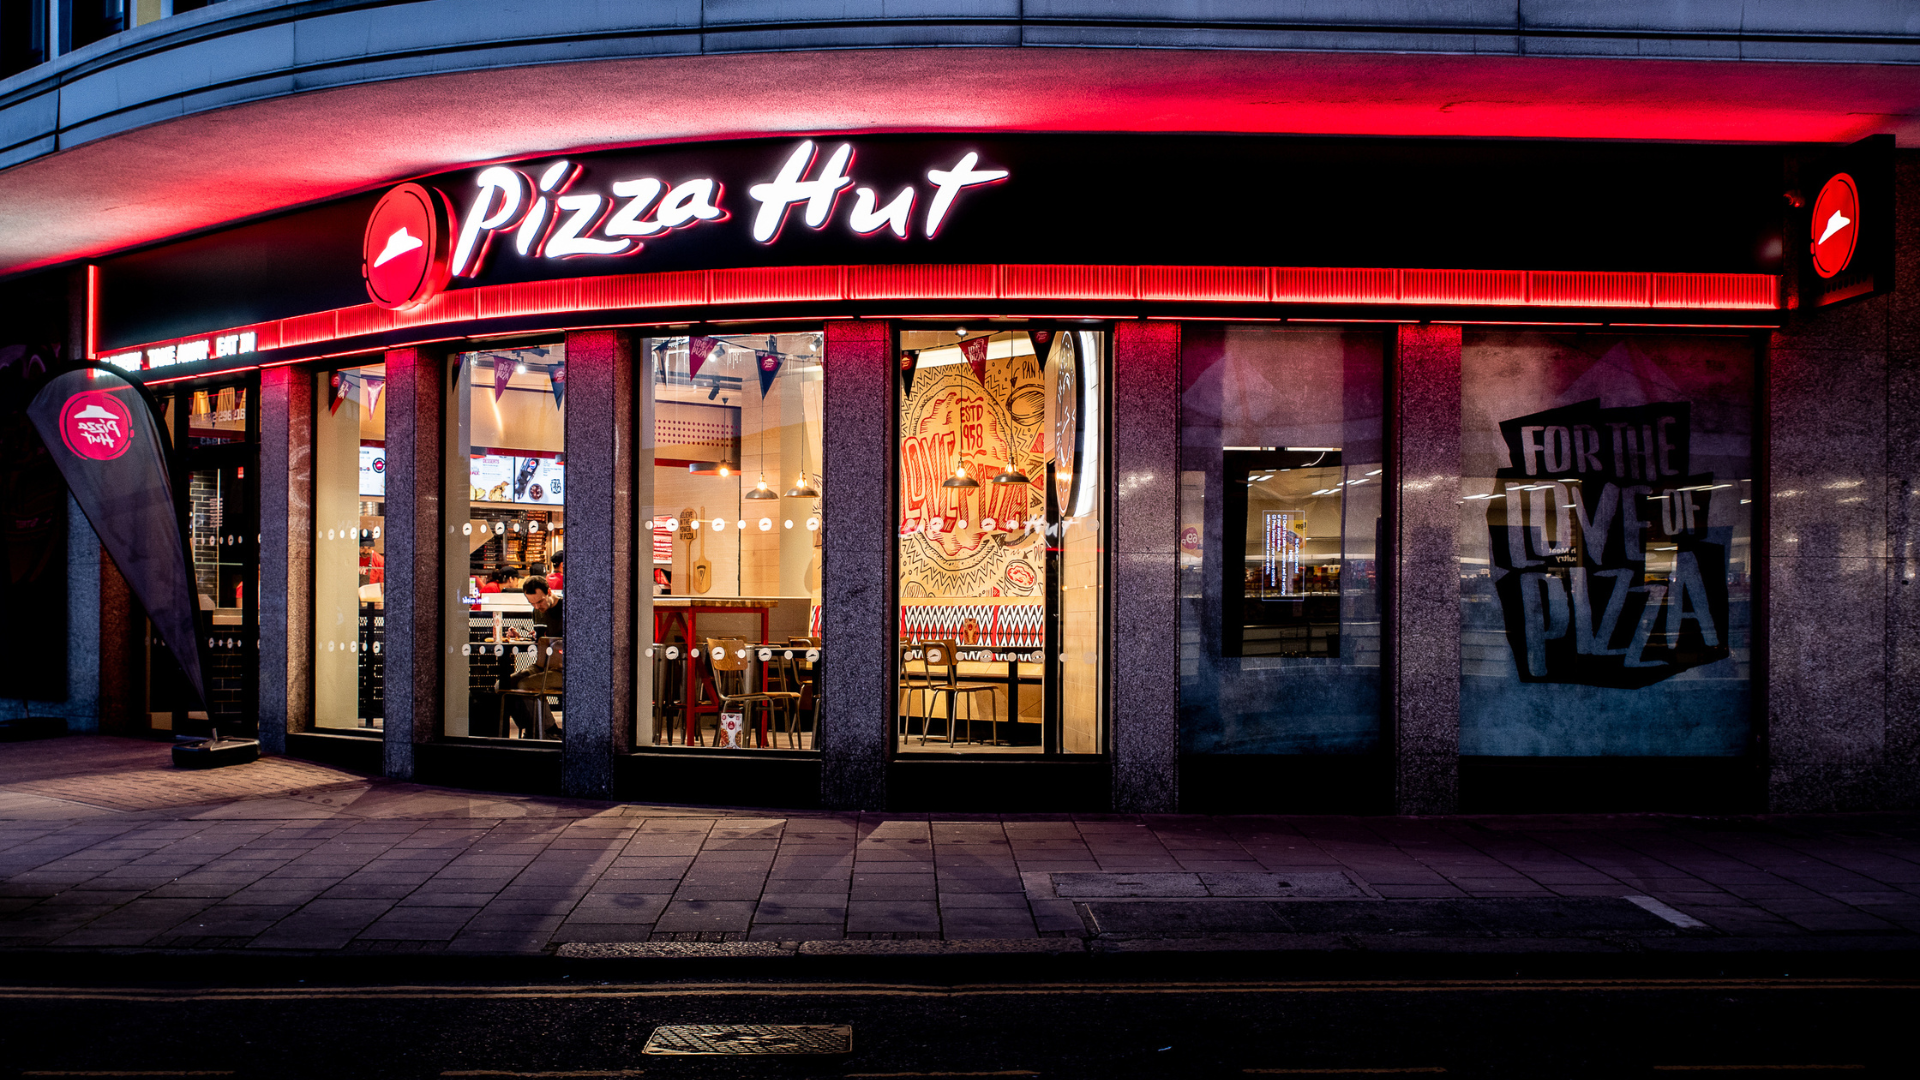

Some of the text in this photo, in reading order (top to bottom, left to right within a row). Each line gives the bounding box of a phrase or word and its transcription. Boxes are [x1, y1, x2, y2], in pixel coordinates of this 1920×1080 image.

[452, 140, 1009, 277] Pizza Hut
[960, 404, 983, 423] ESTD
[1022, 361, 1036, 379] PAN
[900, 430, 958, 533] LOVE
[1521, 416, 1680, 481] FOR THE
[1505, 481, 1700, 569] LOVE OF
[1520, 551, 1719, 677] PIZZA
